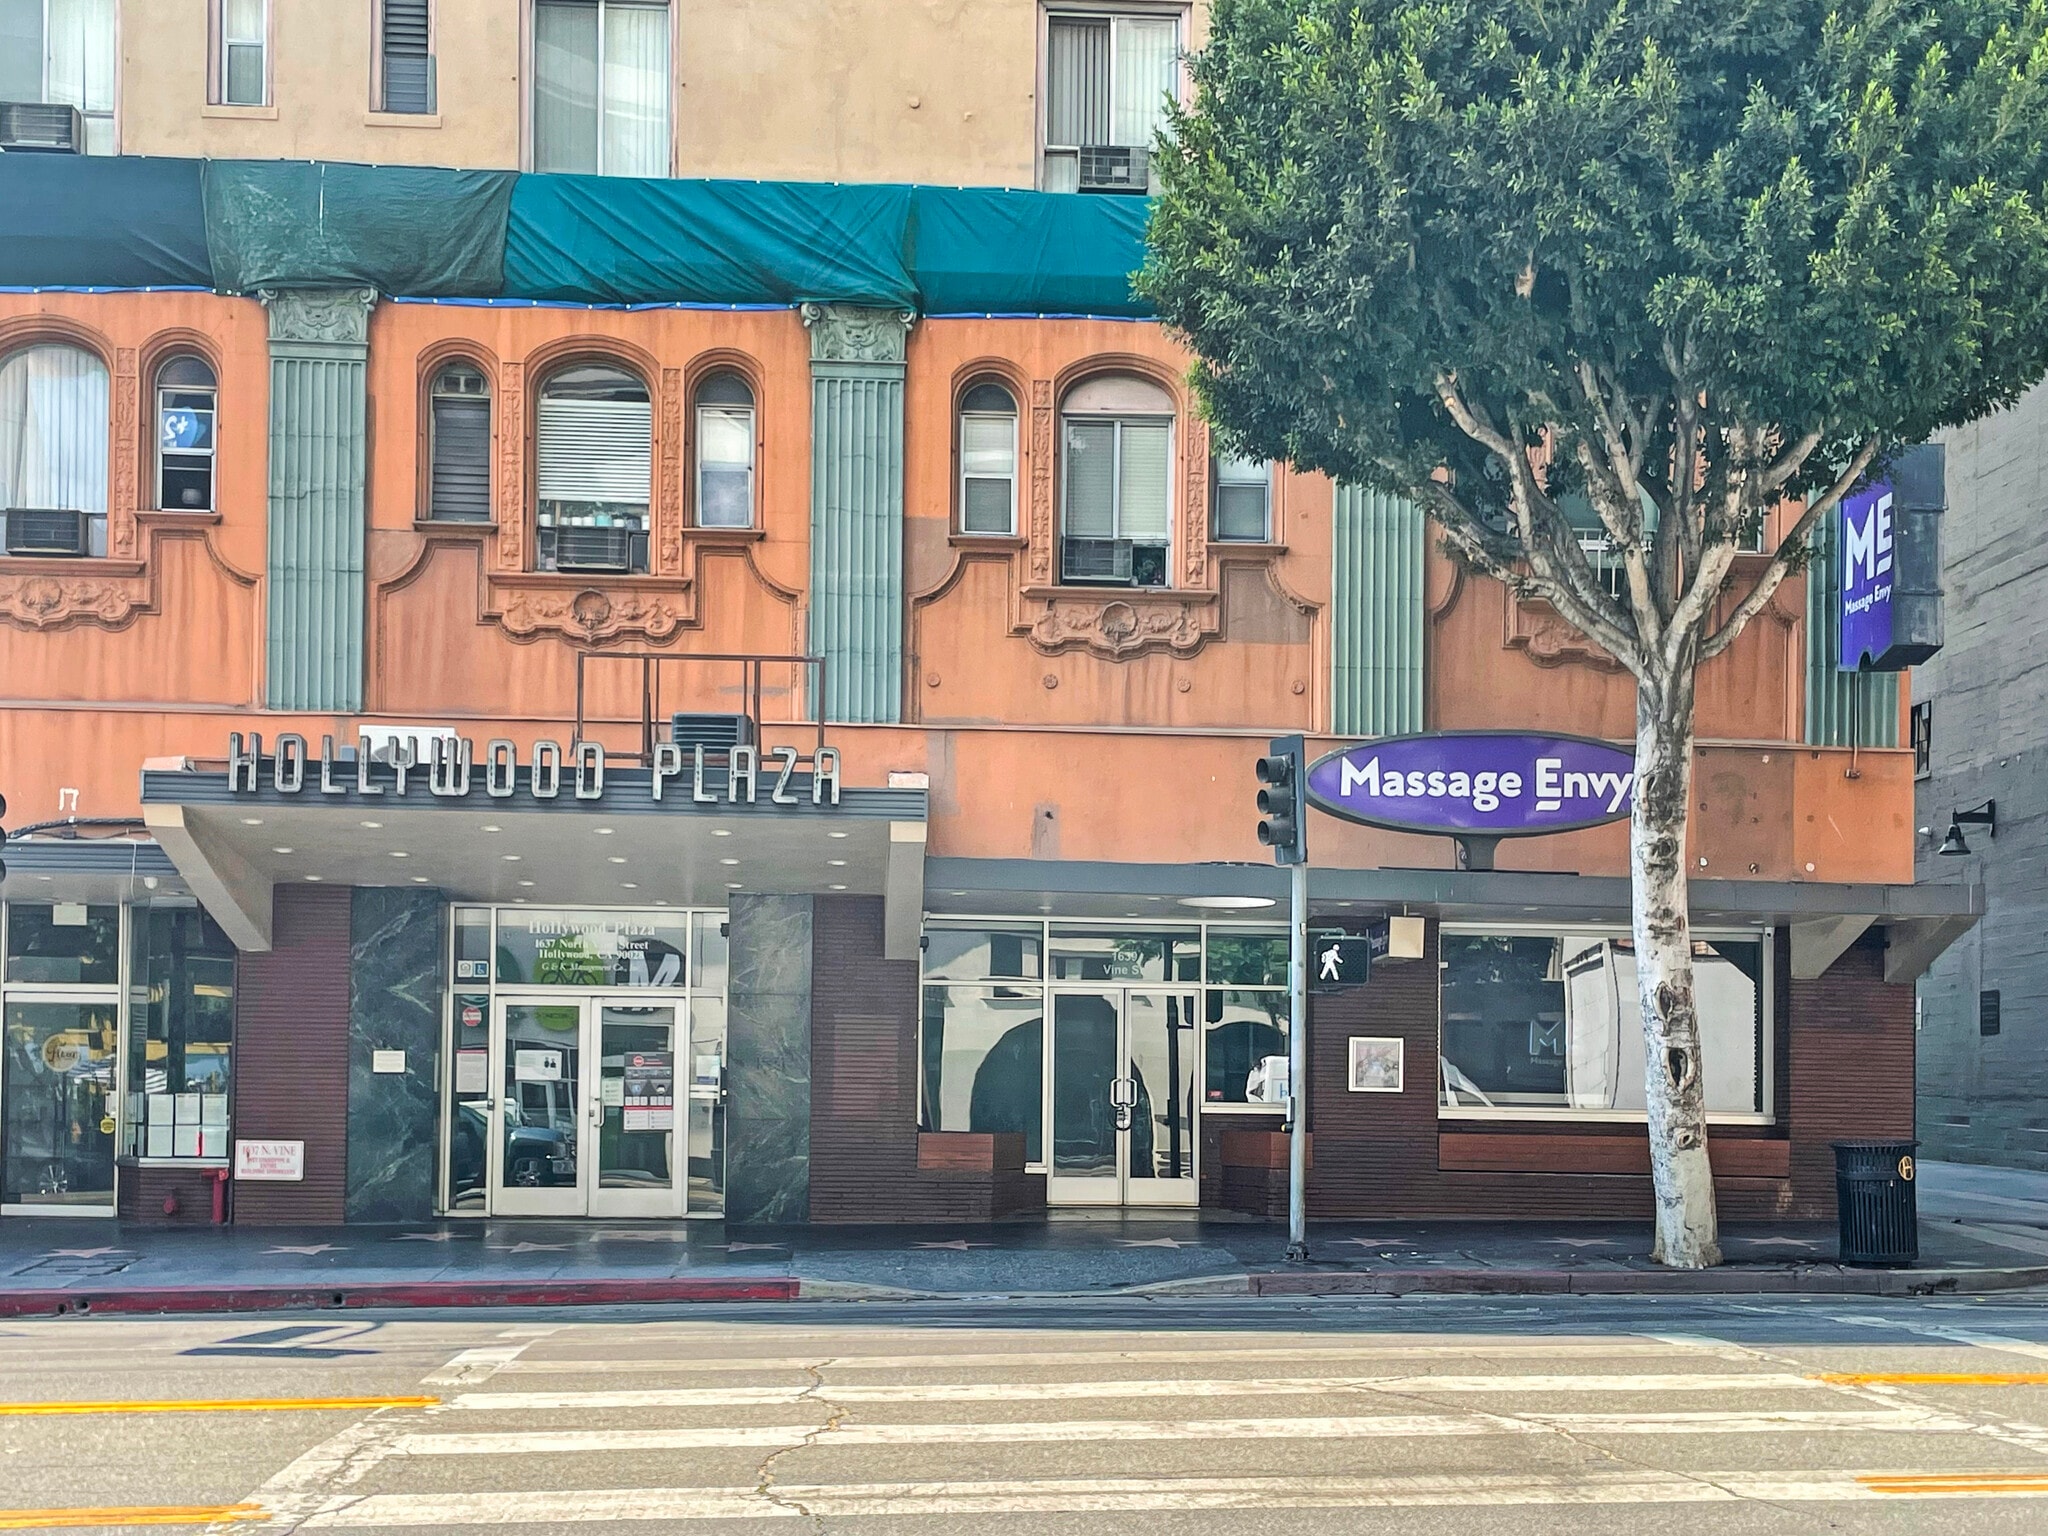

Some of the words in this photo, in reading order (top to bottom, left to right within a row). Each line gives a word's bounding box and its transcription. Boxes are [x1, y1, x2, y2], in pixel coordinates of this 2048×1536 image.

[1845, 492, 1893, 592] ME
[1844, 596, 1874, 617] Massage
[1874, 583, 1892, 603] Envy
[228, 731, 606, 800] HOLLYWOOD
[652, 742, 841, 805] PLAZA
[1340, 755, 1523, 813] Massage
[1535, 757, 1634, 814] Envy
[528, 920, 607, 937] Hollywood
[615, 921, 656, 936] Plaza
[535, 938, 556, 949] 1637
[559, 938, 589, 949] North
[618, 940, 650, 950] Street
[538, 949, 594, 960] Hollywood,
[1112, 951, 1138, 961] 1639
[1103, 964, 1128, 975] Vine
[273, 1145, 297, 1157] VINE
